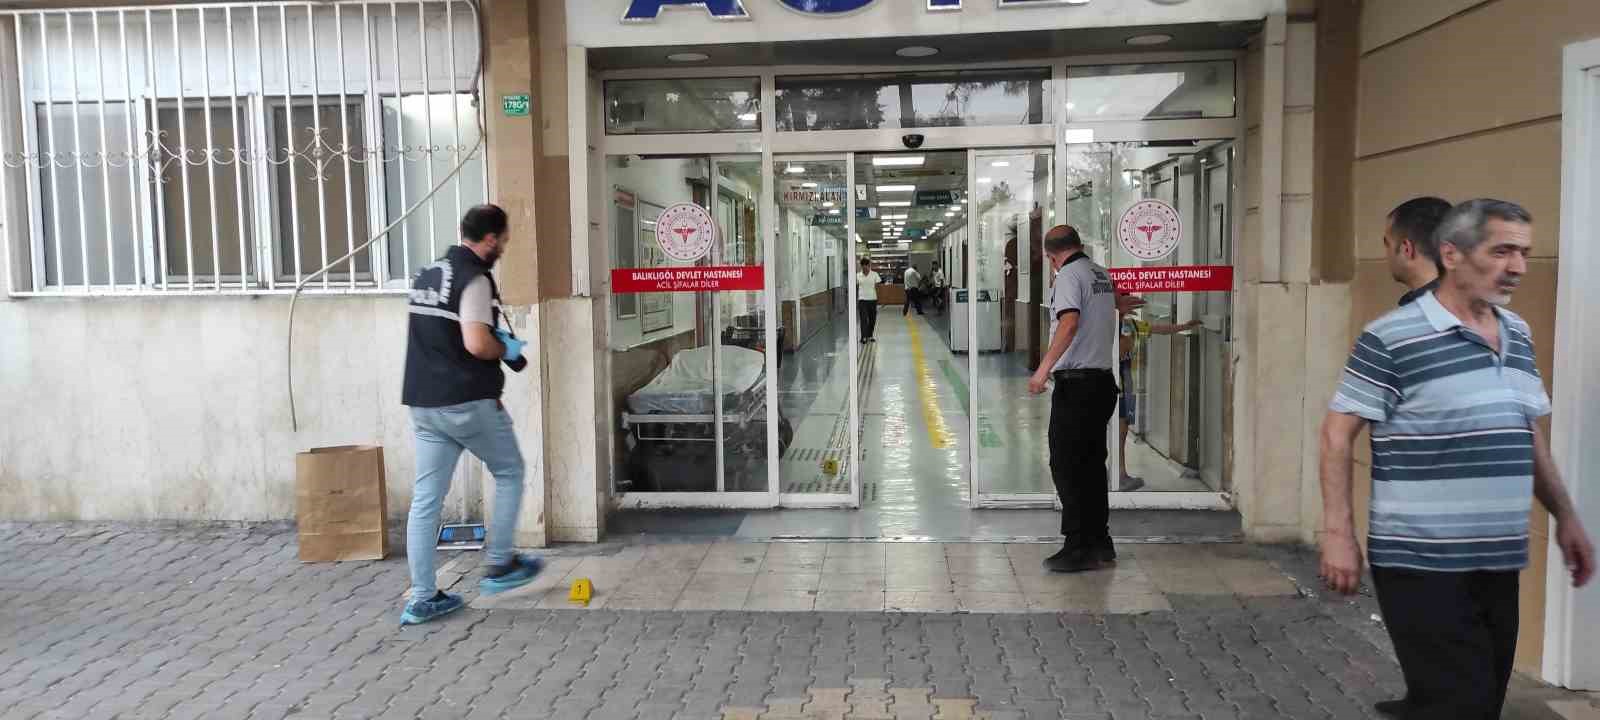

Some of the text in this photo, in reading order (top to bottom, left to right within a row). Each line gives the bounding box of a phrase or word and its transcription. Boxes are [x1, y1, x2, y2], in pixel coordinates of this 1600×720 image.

[632, 268, 743, 281] BALIKLIGÖL DEVLET HASTANESİ
[1138, 270, 1167, 280] DEVLET
[1168, 267, 1212, 279] HASTANESİ
